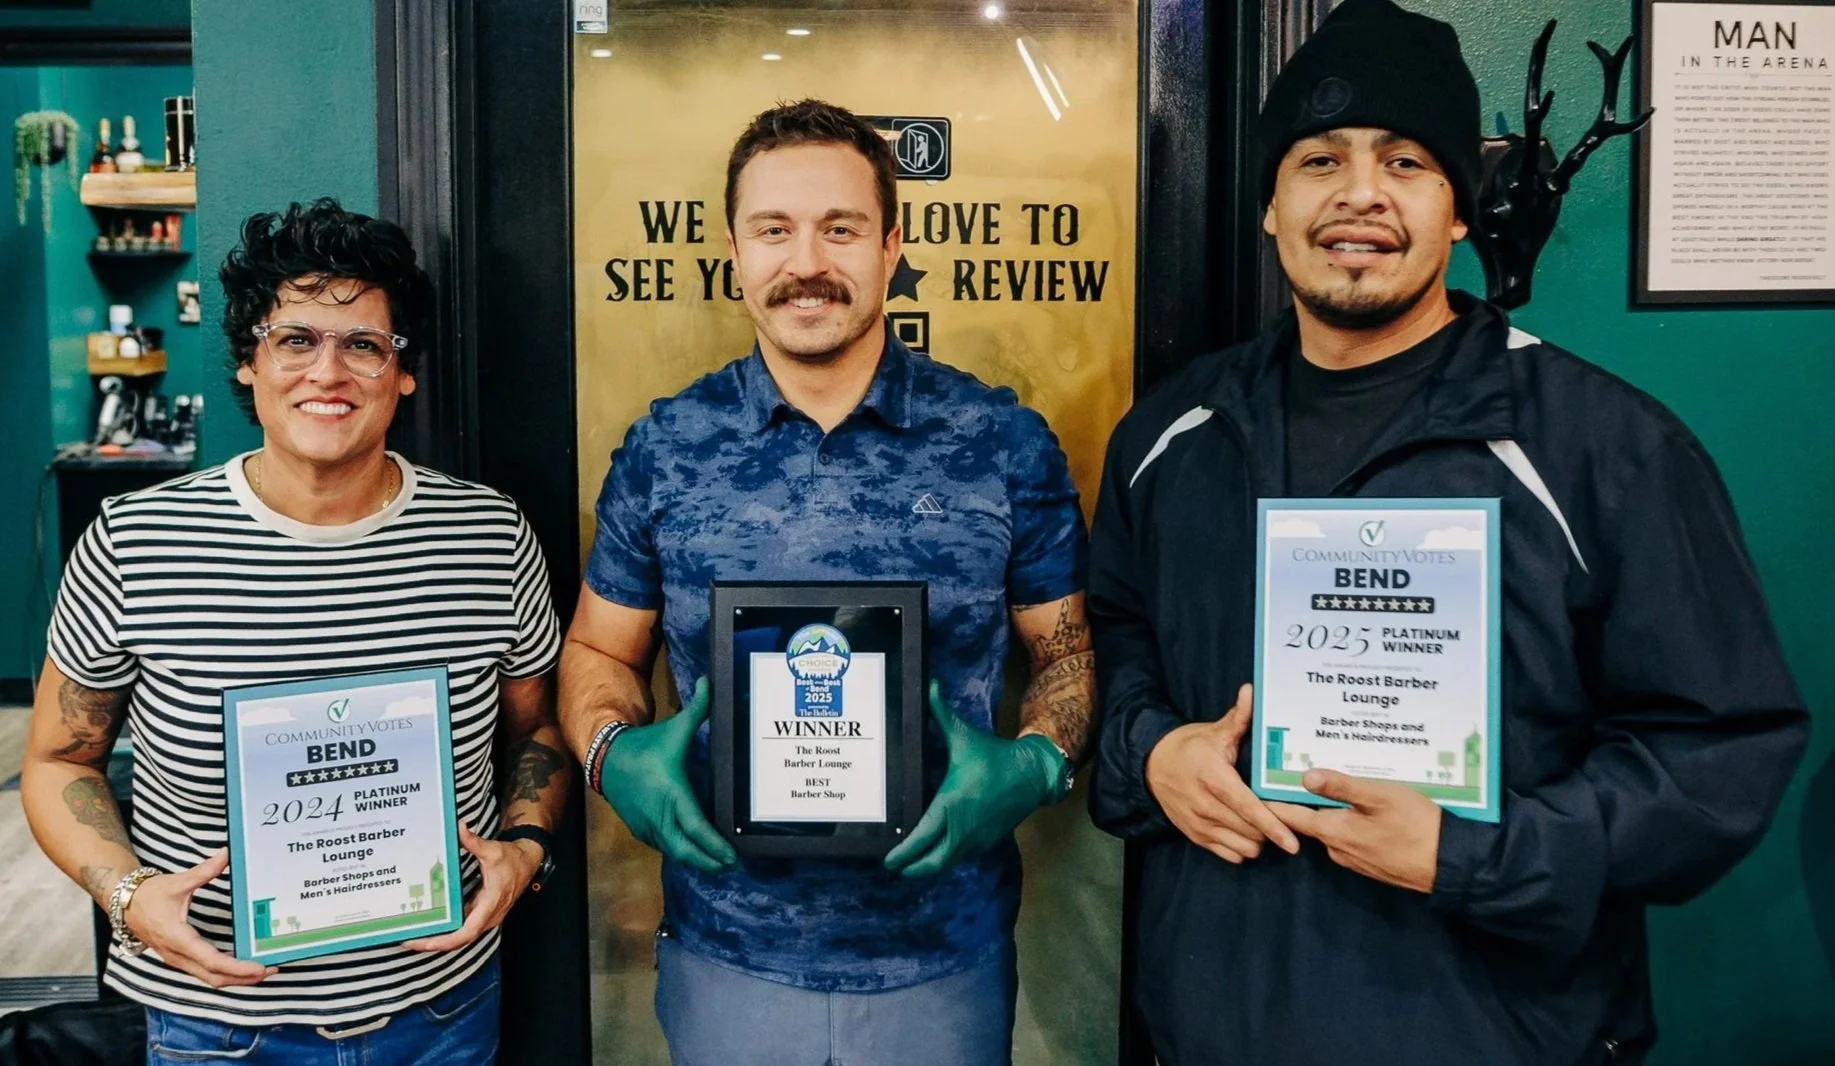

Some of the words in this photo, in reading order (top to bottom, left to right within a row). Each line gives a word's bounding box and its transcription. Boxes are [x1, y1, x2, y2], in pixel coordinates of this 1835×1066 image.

[579, 4, 602, 17] ring
[1714, 20, 1797, 50] MAN
[1681, 55, 1701, 68] IN
[1713, 55, 1751, 69] THE
[1762, 57, 1829, 69] ARENA
[638, 200, 705, 244] WE
[902, 201, 1001, 245] LOVE
[1022, 203, 1080, 246] TO
[604, 258, 674, 302] SEE
[953, 259, 1110, 303] REVIEW
[1334, 567, 1411, 590] BEND
[1284, 623, 1373, 657] 2025
[1382, 627, 1461, 641] PLATINUM
[1383, 640, 1444, 654] WINNER
[1306, 671, 1334, 686] The
[1337, 673, 1380, 688] Roost
[1384, 675, 1439, 691] Barber
[804, 692, 833, 703] 2025
[1342, 691, 1400, 709] Lounge
[774, 720, 862, 737] WINNER
[1320, 716, 1359, 729] Barber
[1362, 719, 1398, 733] Shops
[1401, 722, 1425, 733] and
[1351, 731, 1429, 747] Hairdressers
[306, 738, 377, 764] BEND
[795, 746, 813, 756] The
[815, 746, 841, 756] Roost
[784, 759, 816, 769] Barber
[818, 759, 853, 770] Lounge
[805, 778, 831, 787] BEST
[790, 790, 821, 799] Barber
[823, 790, 846, 801] Shop
[260, 793, 344, 827] 2024
[354, 782, 421, 801] PLATINUM
[355, 796, 408, 813] WINNER
[287, 839, 313, 854] The
[316, 832, 356, 849] Roost
[358, 826, 406, 843] Barber
[322, 847, 374, 863] Lounge
[303, 874, 340, 888] Barber
[342, 869, 374, 882] Shops
[376, 865, 396, 877] and
[300, 887, 332, 900] Men's
[334, 876, 402, 895] Hairdressers
